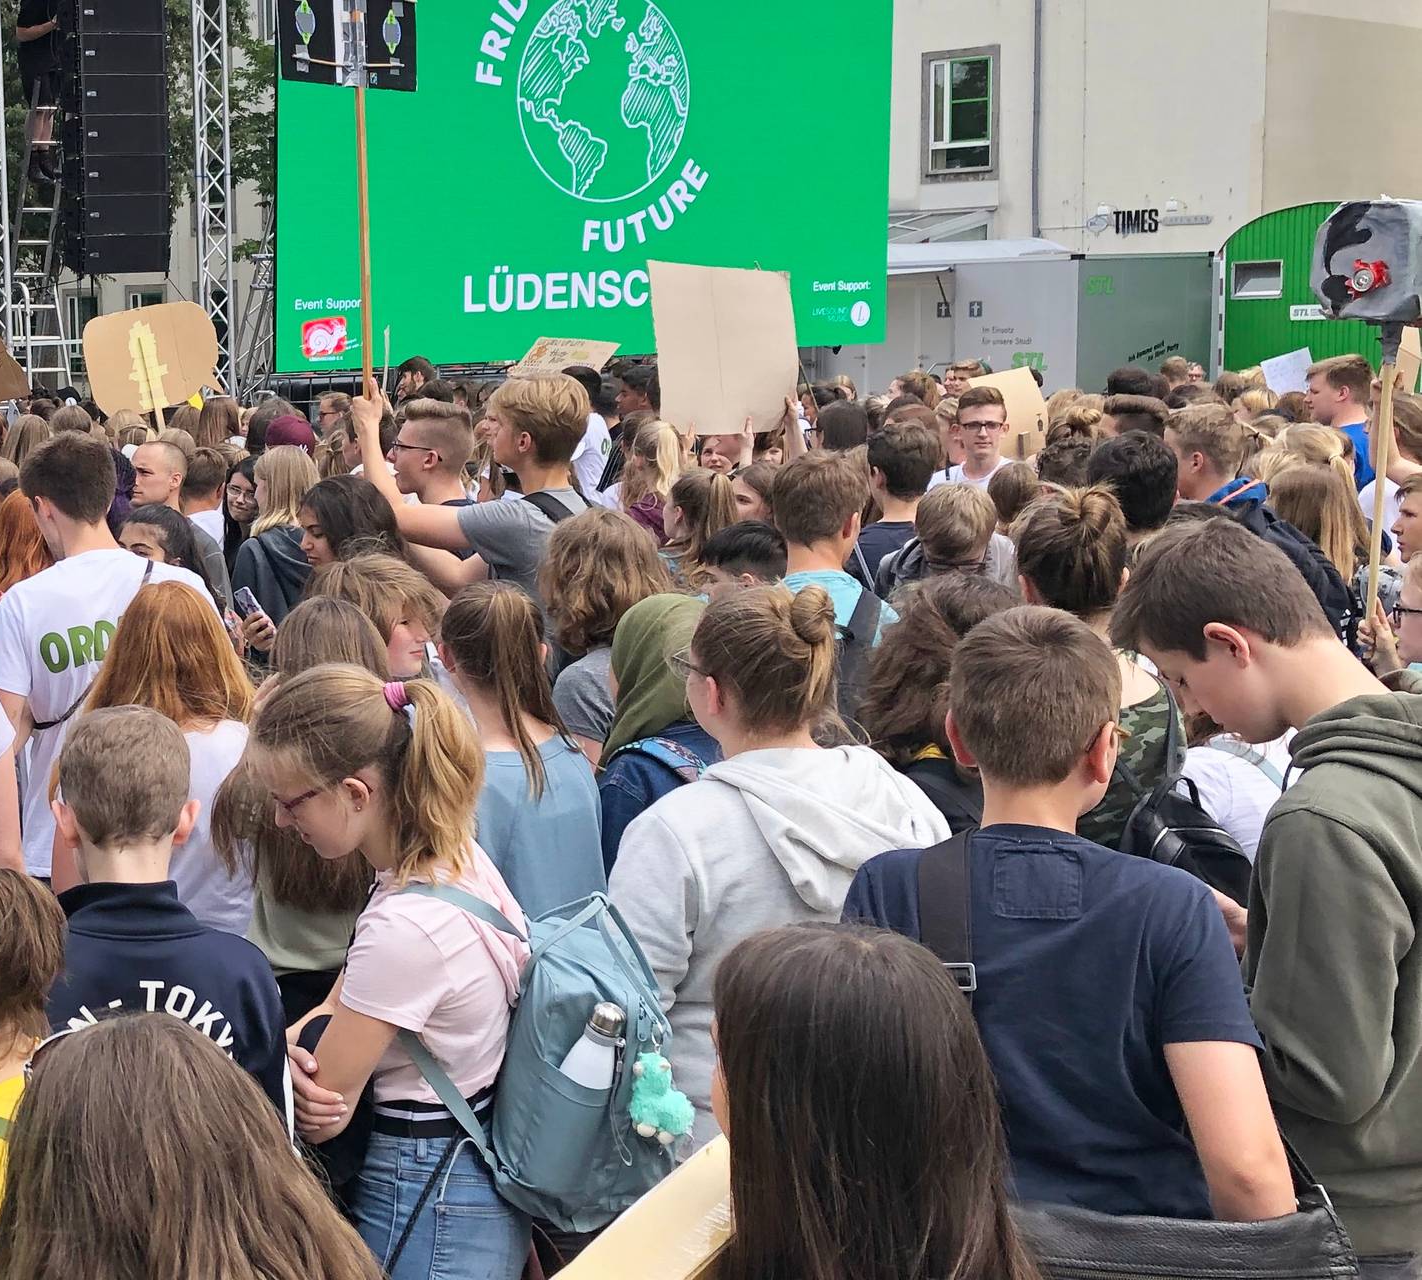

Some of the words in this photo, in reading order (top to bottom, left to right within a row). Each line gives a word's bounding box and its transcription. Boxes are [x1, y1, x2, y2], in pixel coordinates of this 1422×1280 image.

[582, 158, 709, 252] FUTURE
[1113, 209, 1158, 234] TIMES
[464, 265, 650, 313] LÜDENSC
[813, 281, 836, 292] Event
[1086, 276, 1115, 296] STL
[294, 299, 323, 311] Event
[326, 297, 362, 311] Suppor
[1011, 351, 1048, 372] STL
[40, 617, 120, 673] ORD
[139, 980, 234, 1060] TOKY
